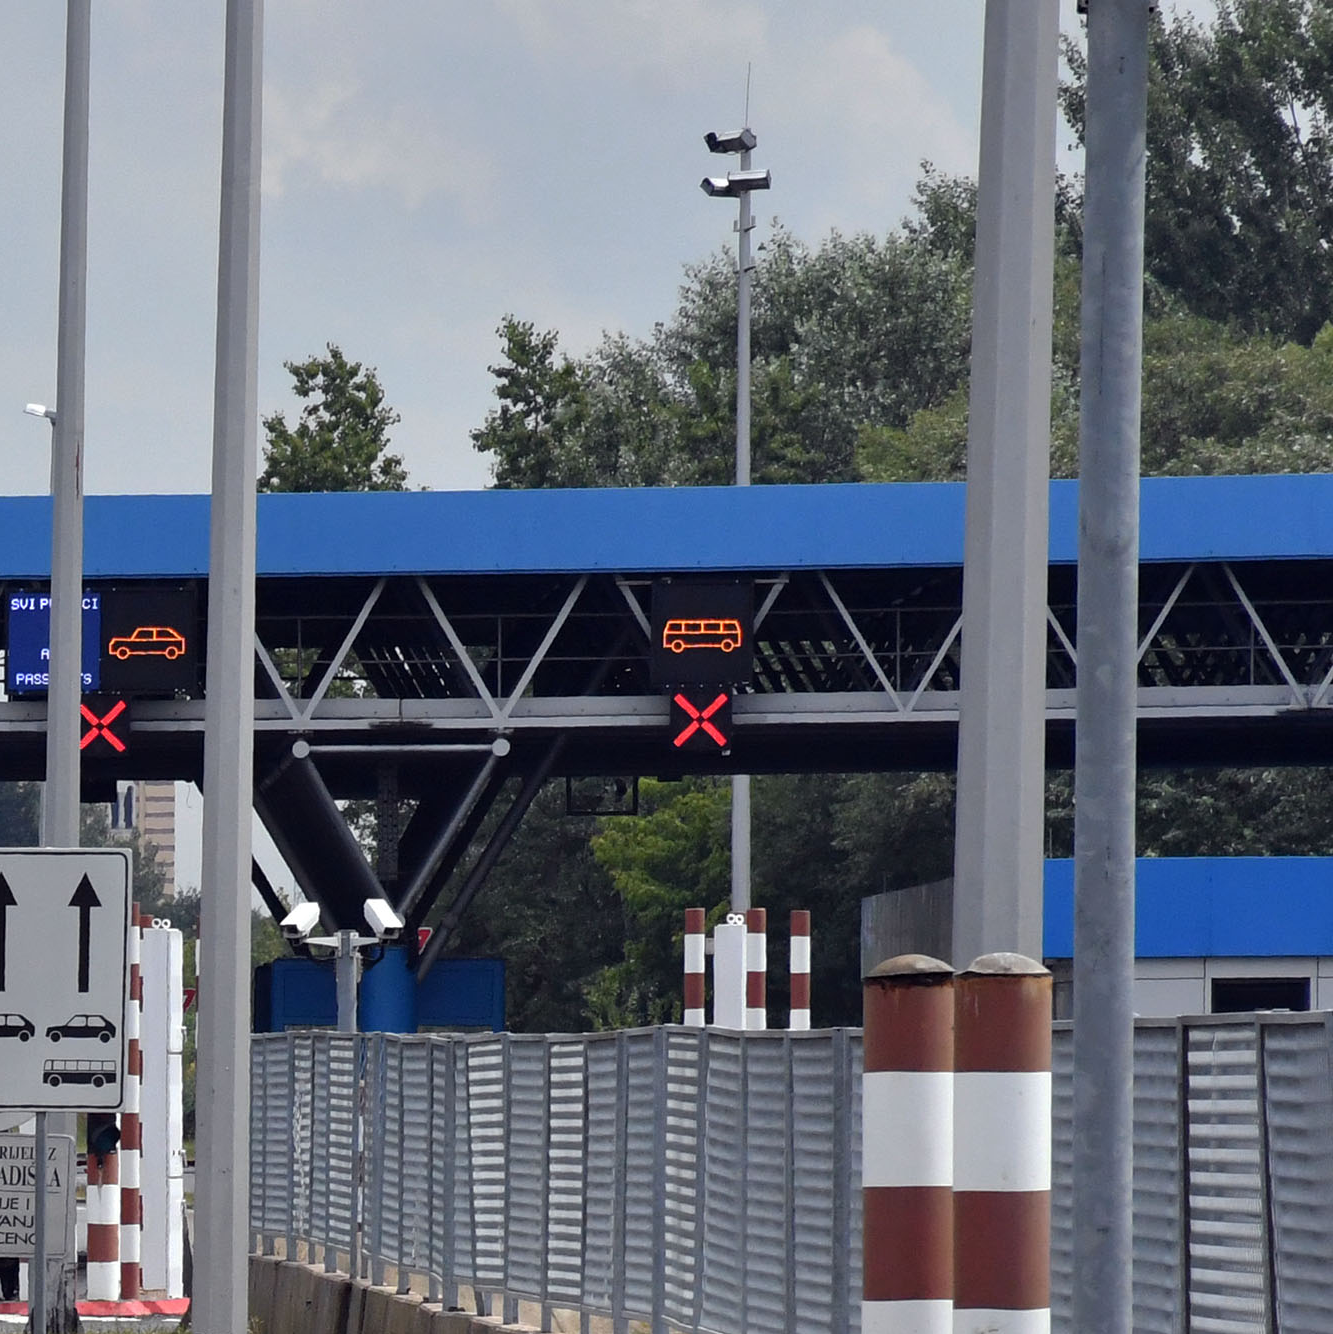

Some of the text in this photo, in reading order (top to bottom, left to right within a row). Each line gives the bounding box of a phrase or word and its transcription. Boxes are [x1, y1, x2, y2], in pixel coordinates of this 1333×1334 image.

[10, 598, 35, 610] SVI
[15, 673, 92, 685] PASSS
[26, 1198, 30, 1210] I
